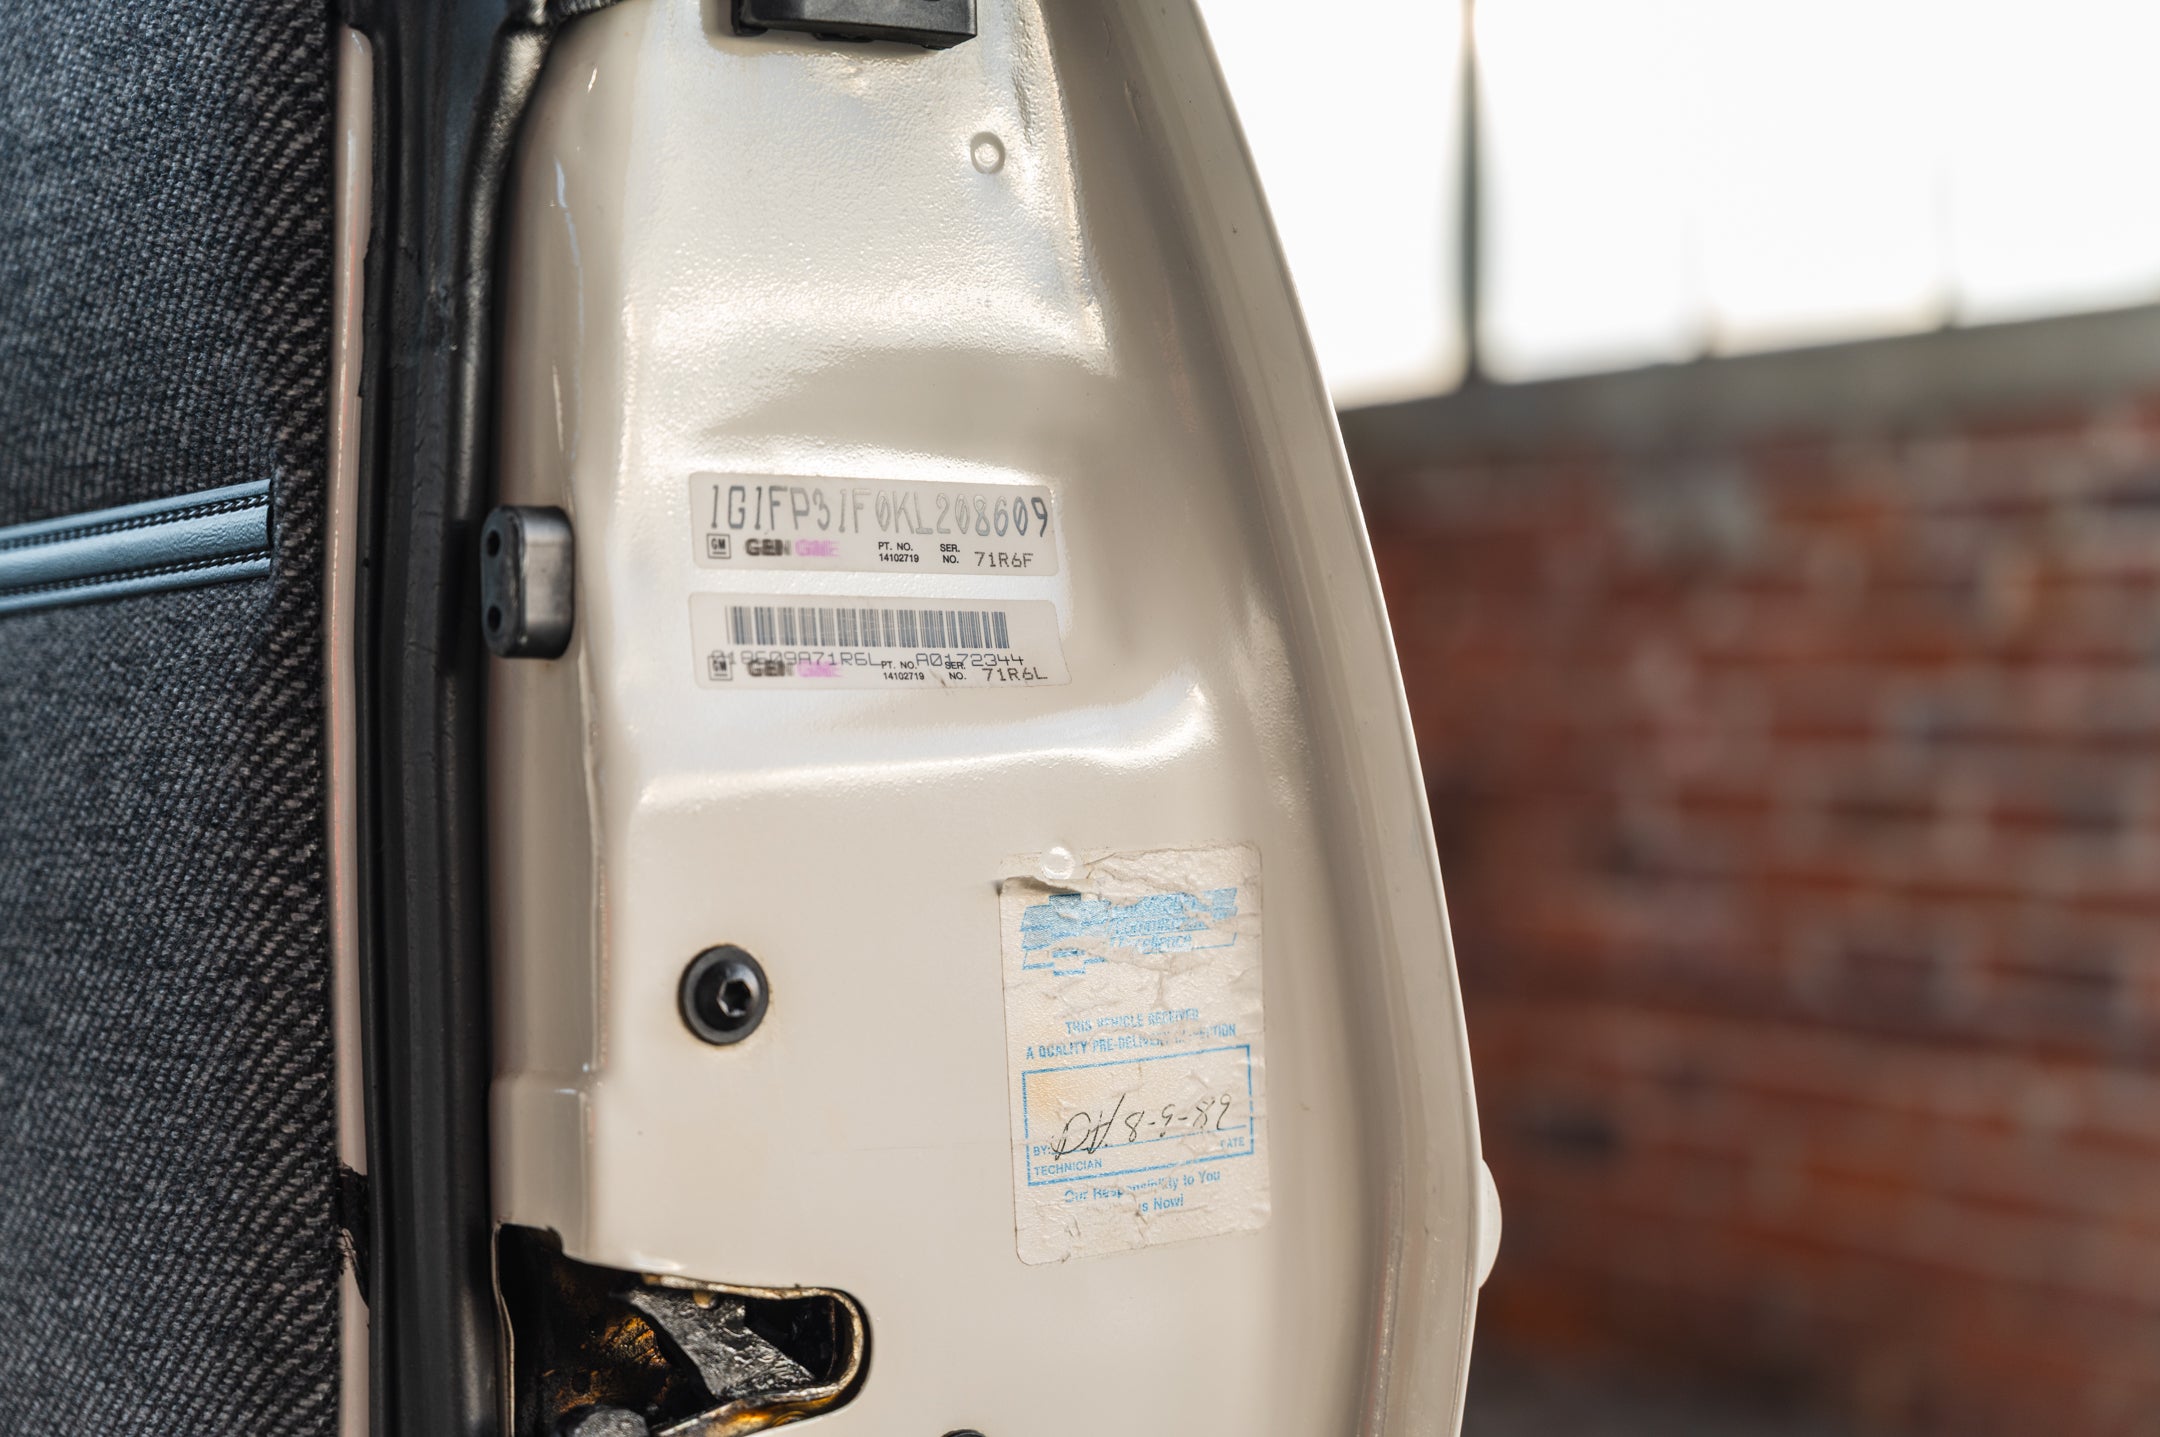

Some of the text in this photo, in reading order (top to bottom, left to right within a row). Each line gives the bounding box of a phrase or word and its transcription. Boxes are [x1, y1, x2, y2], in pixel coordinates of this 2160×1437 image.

[878, 541, 914, 551] PT. NO.
[939, 543, 961, 553] SER.
[879, 553, 920, 563] 14102719
[942, 554, 960, 564] NO.
[974, 551, 1034, 568] 71R6F
[881, 660, 918, 670] PT. NO.
[944, 660, 967, 670] SER.
[883, 671, 925, 681] 14102719
[948, 671, 967, 681] NO.
[982, 667, 1048, 682] 71R6L
[1025, 1045, 1035, 1060] A
[1033, 1158, 1103, 1177] TECHNICIAN
[1182, 1172, 1195, 1187] to
[1198, 1169, 1222, 1186] You
